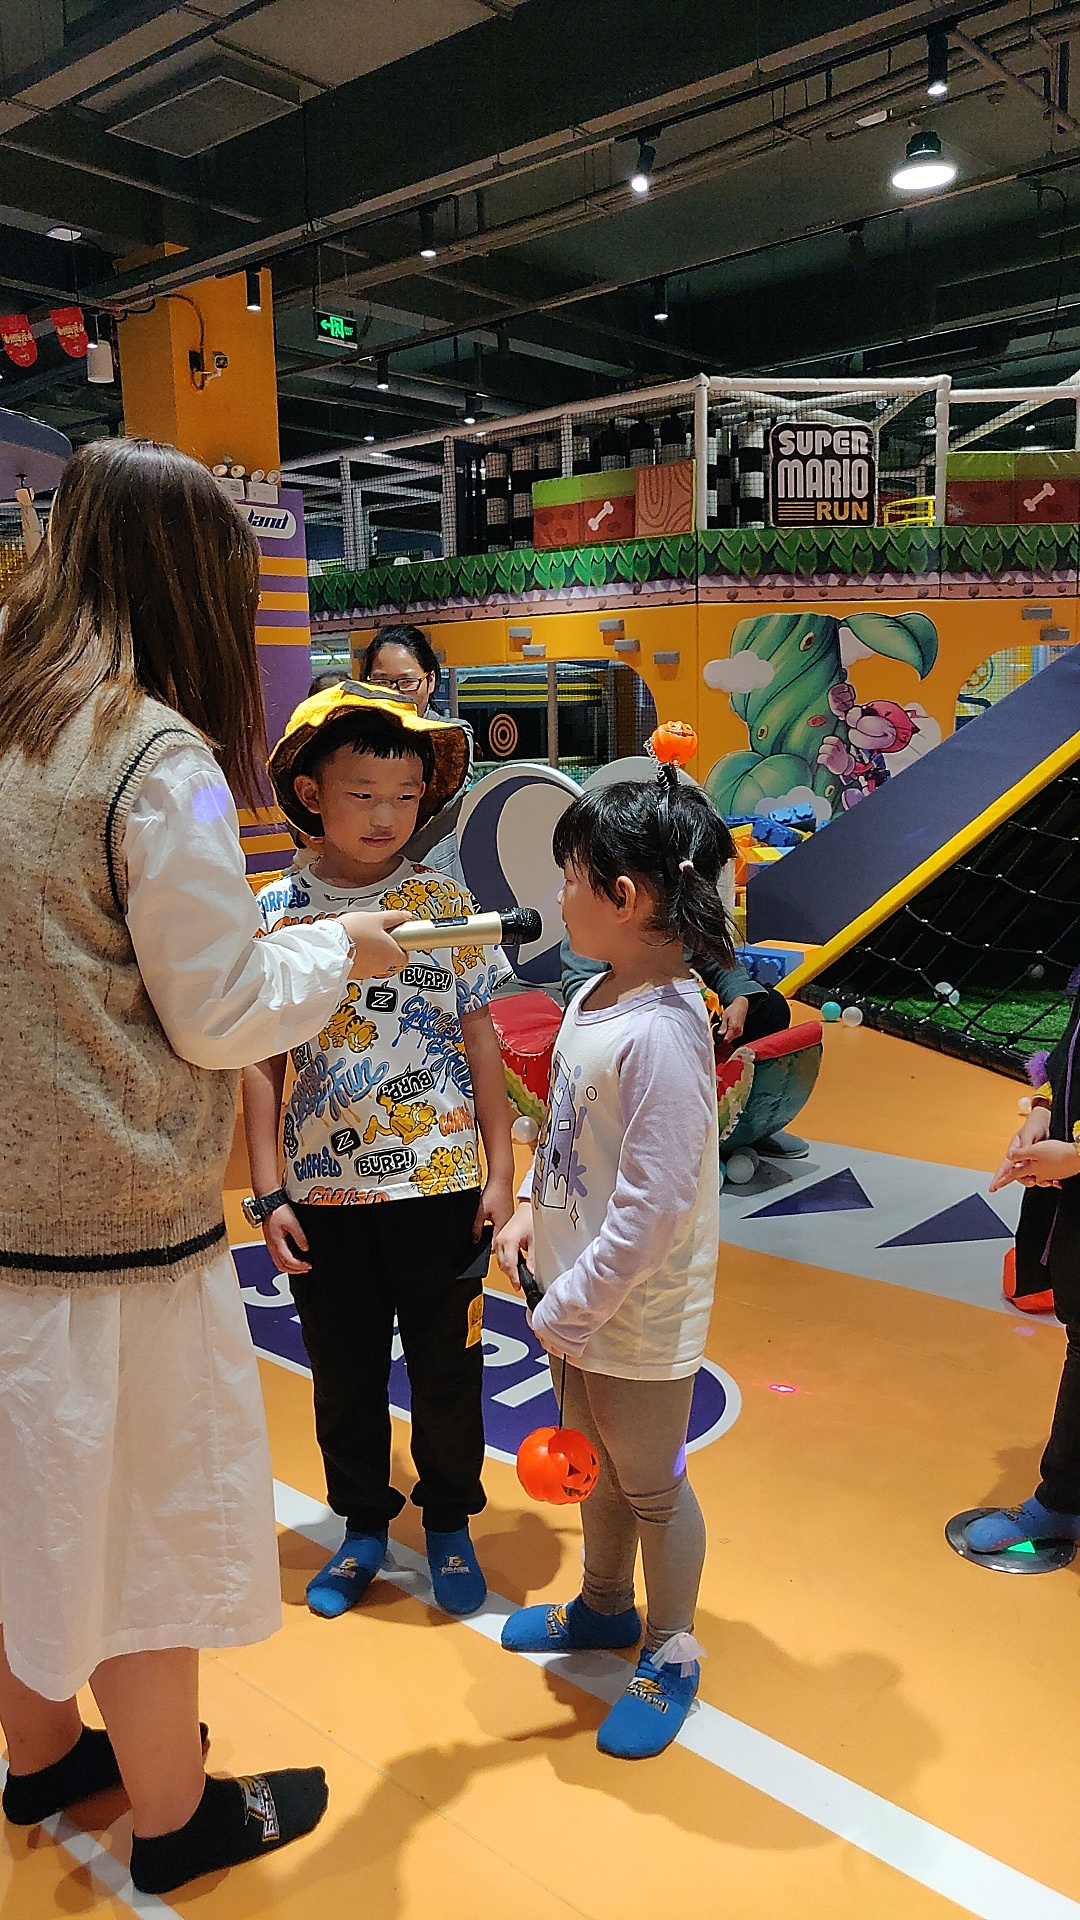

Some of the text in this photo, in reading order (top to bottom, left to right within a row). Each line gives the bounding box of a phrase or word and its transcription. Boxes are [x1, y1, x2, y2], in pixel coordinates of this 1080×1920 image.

[778, 430, 869, 456] SUPER
[777, 458, 869, 499] MARIO
[816, 501, 868, 520] RUN
[257, 883, 312, 913] ARFIELD
[402, 966, 450, 991] BURP!
[371, 991, 394, 1008] Z
[336, 1130, 355, 1152] Z
[358, 1150, 413, 1177] BURP!
